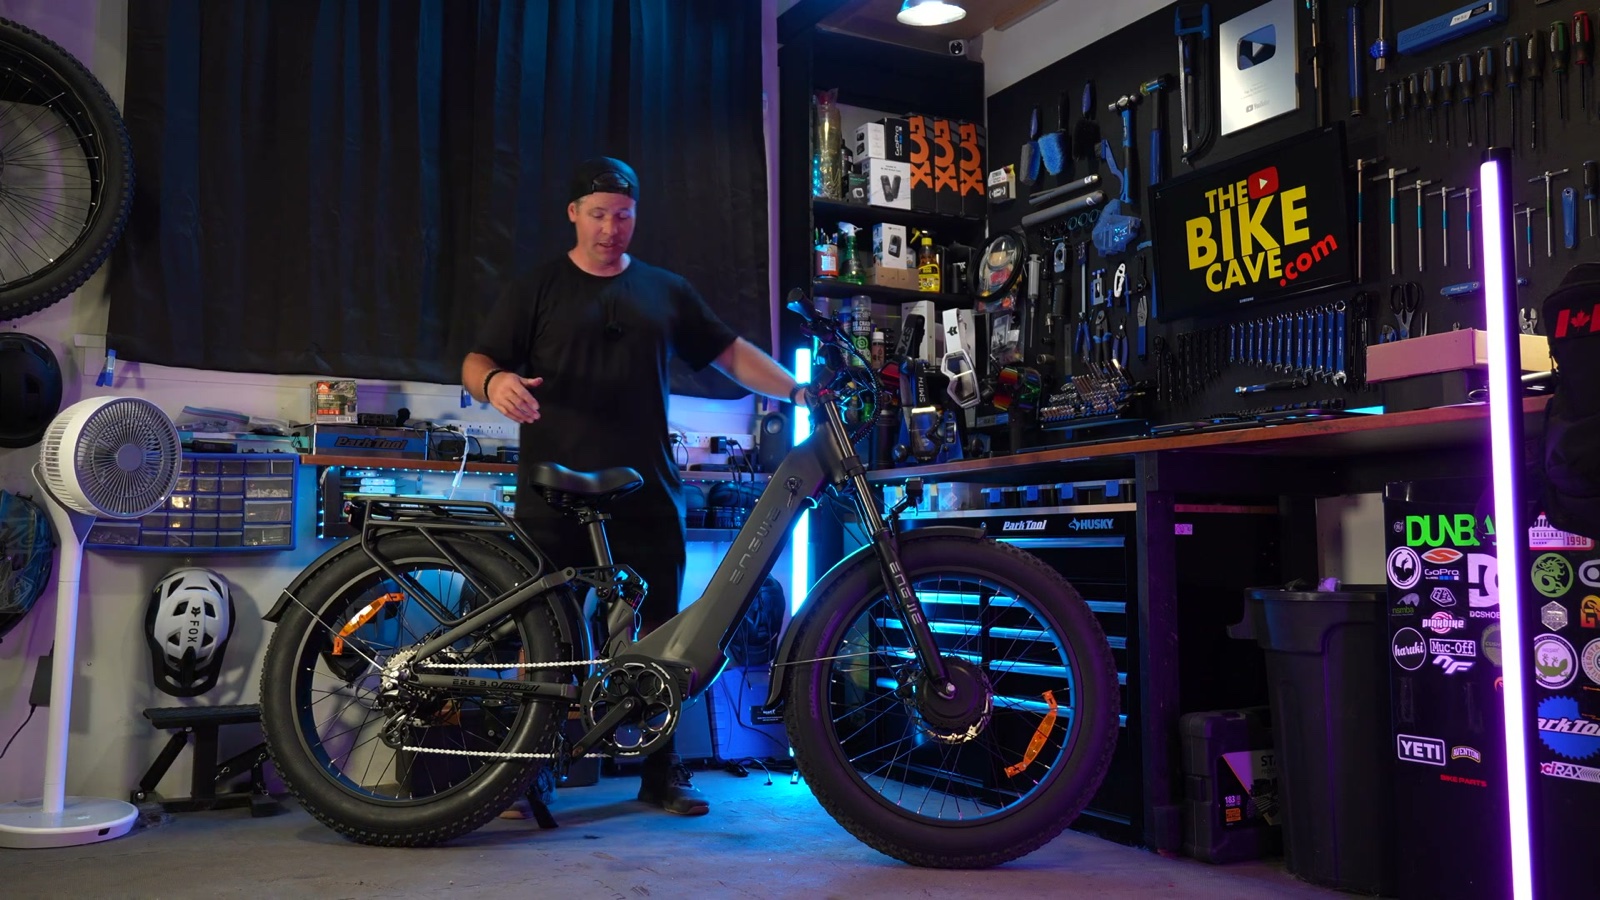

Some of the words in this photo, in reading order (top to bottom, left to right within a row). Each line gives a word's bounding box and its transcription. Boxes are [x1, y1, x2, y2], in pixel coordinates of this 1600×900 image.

[1204, 178, 1249, 213] THE
[1185, 185, 1310, 270] BIKE
[1205, 247, 1284, 292] CAVE
[1279, 233, 1338, 288] .com
[918, 376, 926, 402] SMITH
[335, 436, 373, 448] Park
[374, 438, 408, 450] Tool
[1002, 520, 1025, 531] Park
[1025, 519, 1048, 530] Tool
[1080, 518, 1114, 530] HUSKY
[1566, 536, 1588, 546] 1998
[1424, 568, 1460, 576] GoPro
[187, 620, 200, 643] FOX
[1394, 641, 1425, 657] haruki
[1431, 641, 1474, 655] Muc-Off
[479, 680, 499, 688] 3.0
[1400, 739, 1441, 760] YETI
[1261, 755, 1276, 767] ST
[1440, 774, 1458, 784] BIKE
[1459, 777, 1488, 787] PARTS
